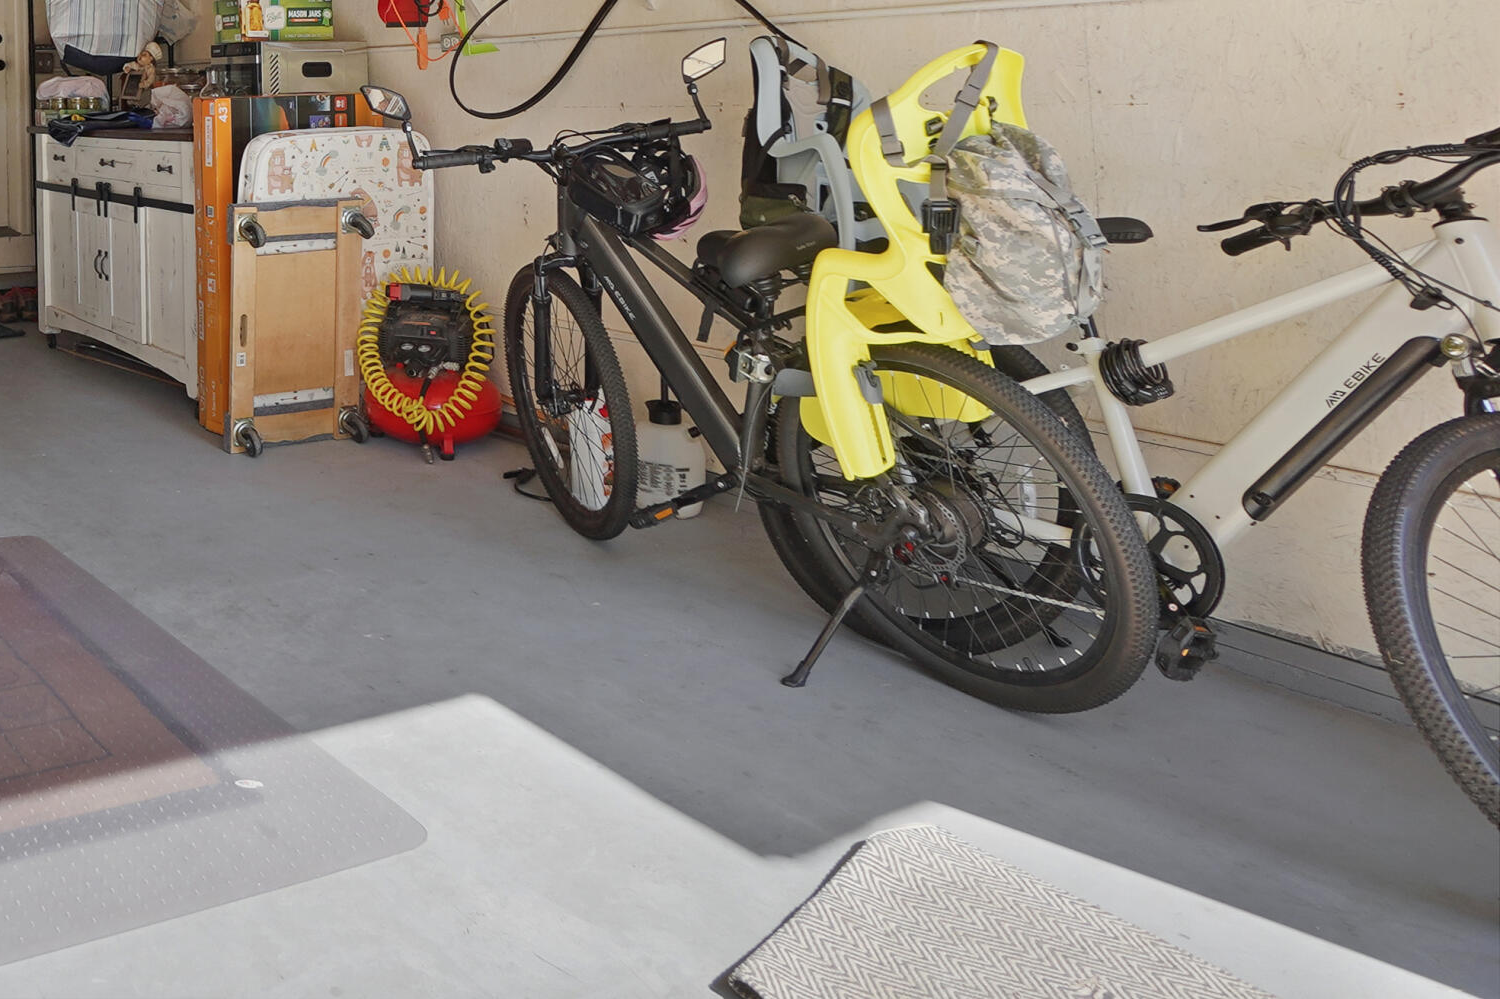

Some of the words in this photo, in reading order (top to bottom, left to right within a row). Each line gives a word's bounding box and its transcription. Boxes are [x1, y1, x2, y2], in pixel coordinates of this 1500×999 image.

[287, 9, 308, 18] MASON
[308, 9, 322, 18] JARS
[1343, 352, 1386, 389] EBIKE
